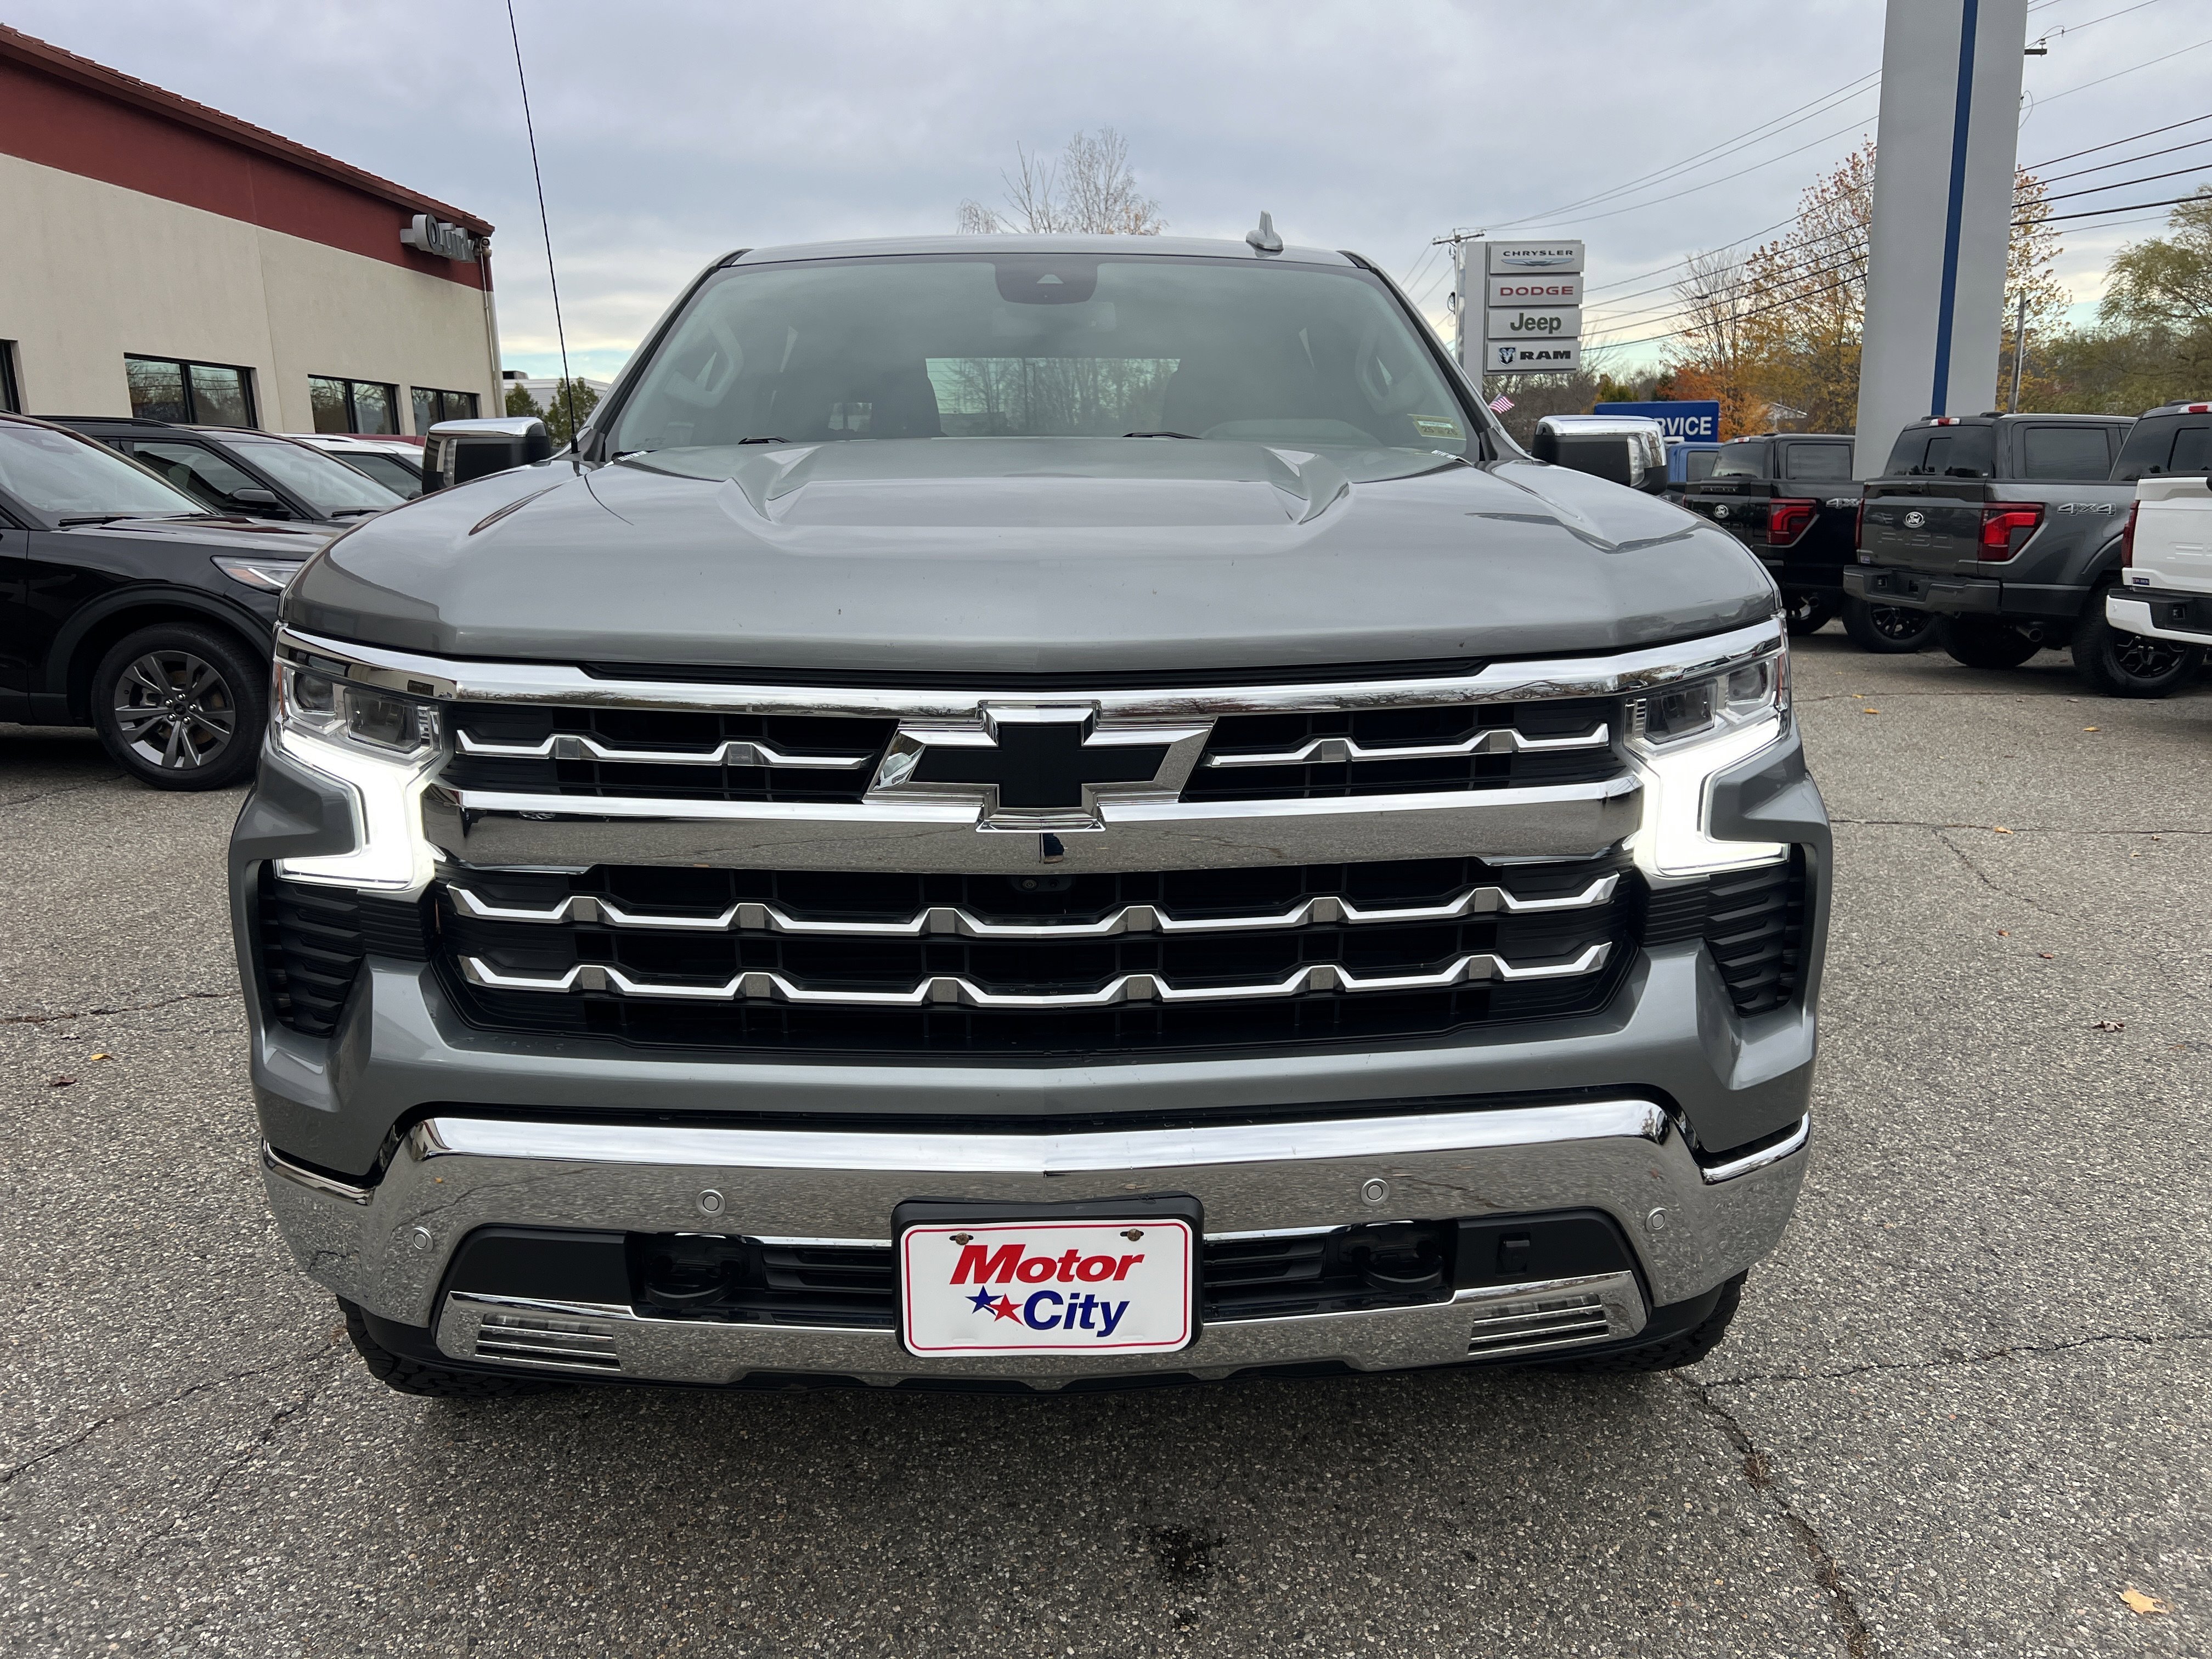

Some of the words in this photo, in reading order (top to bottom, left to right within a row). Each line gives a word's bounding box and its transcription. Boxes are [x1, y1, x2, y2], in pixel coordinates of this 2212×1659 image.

[1500, 286, 1574, 296] DODGE
[1510, 312, 1561, 334] Jeep
[1520, 351, 1571, 360] RAM
[1654, 416, 1712, 436] RVICE
[950, 1244, 1145, 1285] Motor
[1023, 1290, 1130, 1338] City
